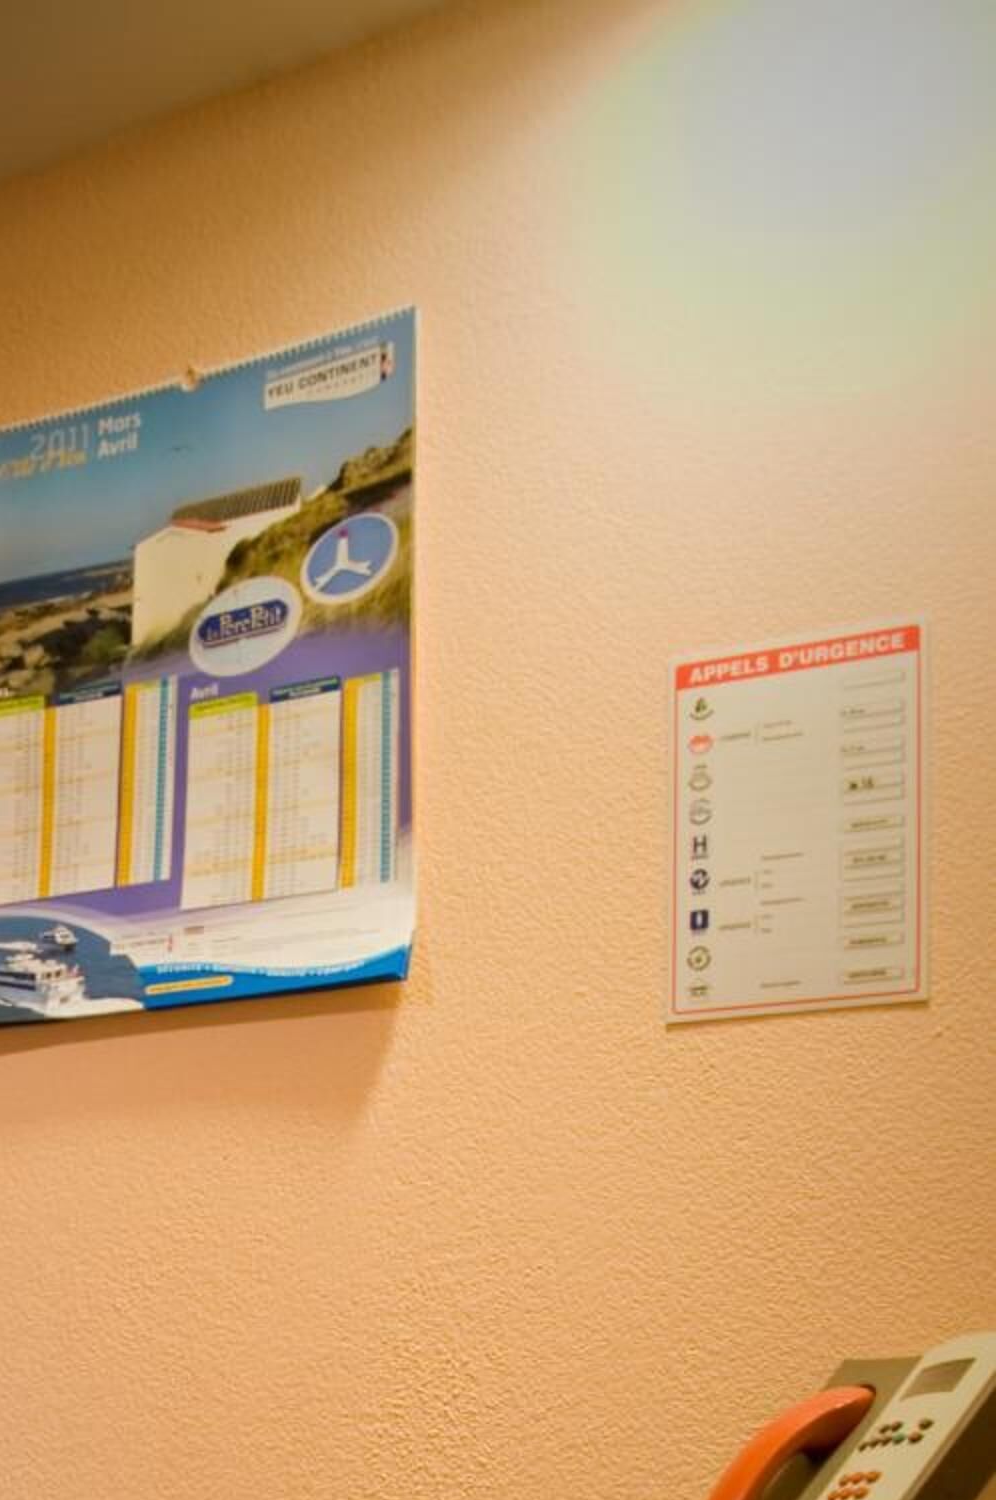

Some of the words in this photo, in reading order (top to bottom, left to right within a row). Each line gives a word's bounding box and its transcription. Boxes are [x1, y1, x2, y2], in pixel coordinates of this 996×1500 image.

[267, 382, 294, 398] YEU
[298, 353, 377, 390] CONTINENT
[97, 412, 141, 434] Mars
[29, 423, 89, 460] 2011
[97, 432, 138, 458] Avril
[689, 656, 770, 684] APPELS
[779, 632, 905, 669] D'URGENCE
[190, 682, 220, 700] Avril
